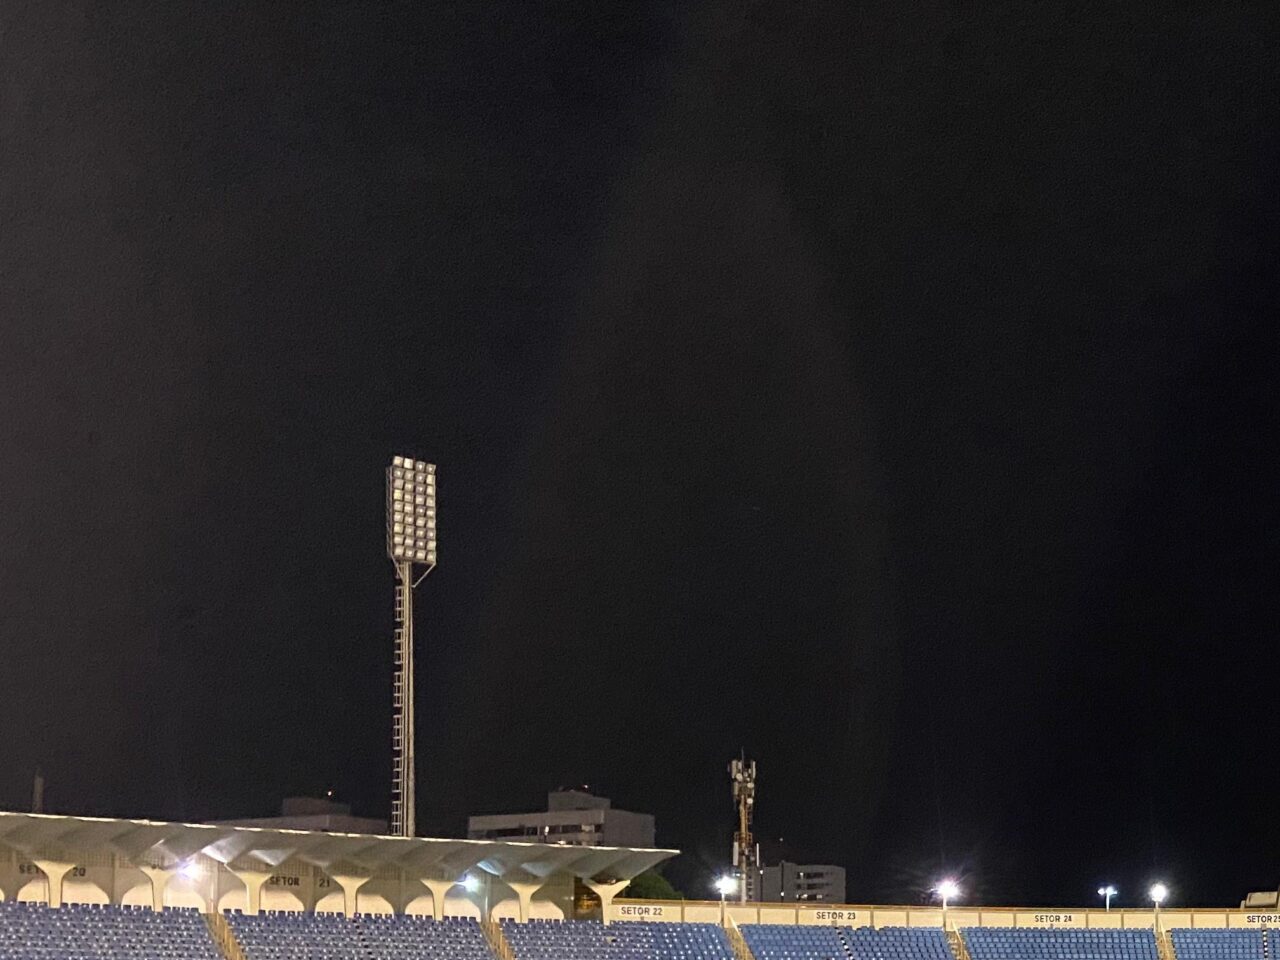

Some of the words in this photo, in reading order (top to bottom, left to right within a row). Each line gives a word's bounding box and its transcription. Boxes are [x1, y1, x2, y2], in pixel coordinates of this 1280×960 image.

[621, 906, 650, 916] SETOR
[653, 907, 663, 916] 22
[816, 911, 844, 920] SETOR
[847, 912, 856, 920] 23
[1034, 914, 1061, 923] SETOR
[1063, 915, 1073, 923] 24
[1246, 915, 1273, 923] SETOR
